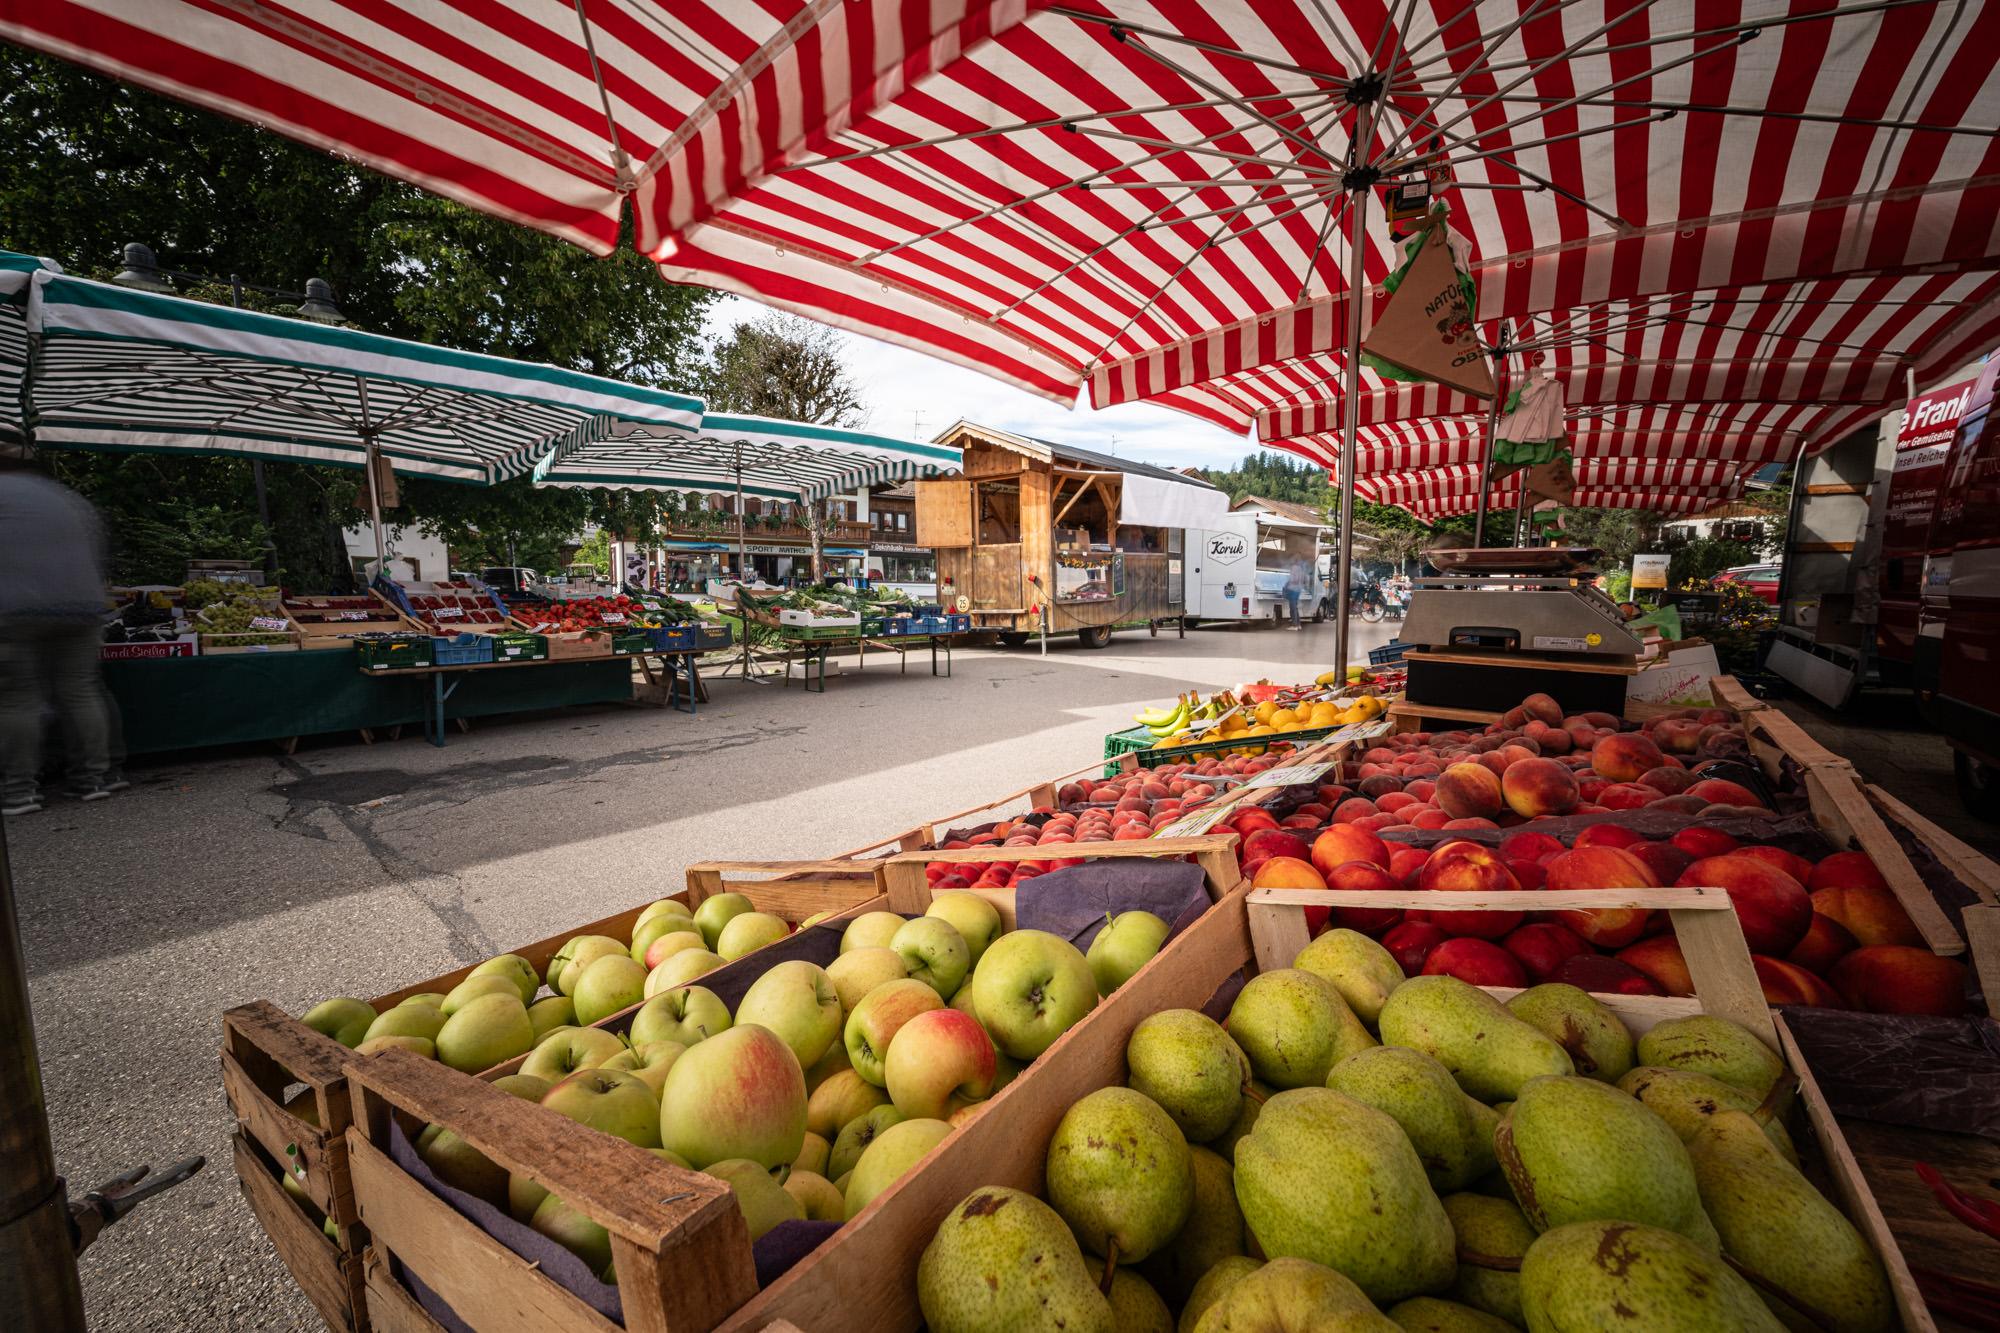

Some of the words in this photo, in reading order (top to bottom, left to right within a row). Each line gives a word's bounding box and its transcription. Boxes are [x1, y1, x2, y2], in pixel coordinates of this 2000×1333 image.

[746, 545, 774, 553] SPORT
[1211, 541, 1243, 554] Koruk
[960, 599, 967, 609] 25
[131, 645, 166, 657] Sicilia
